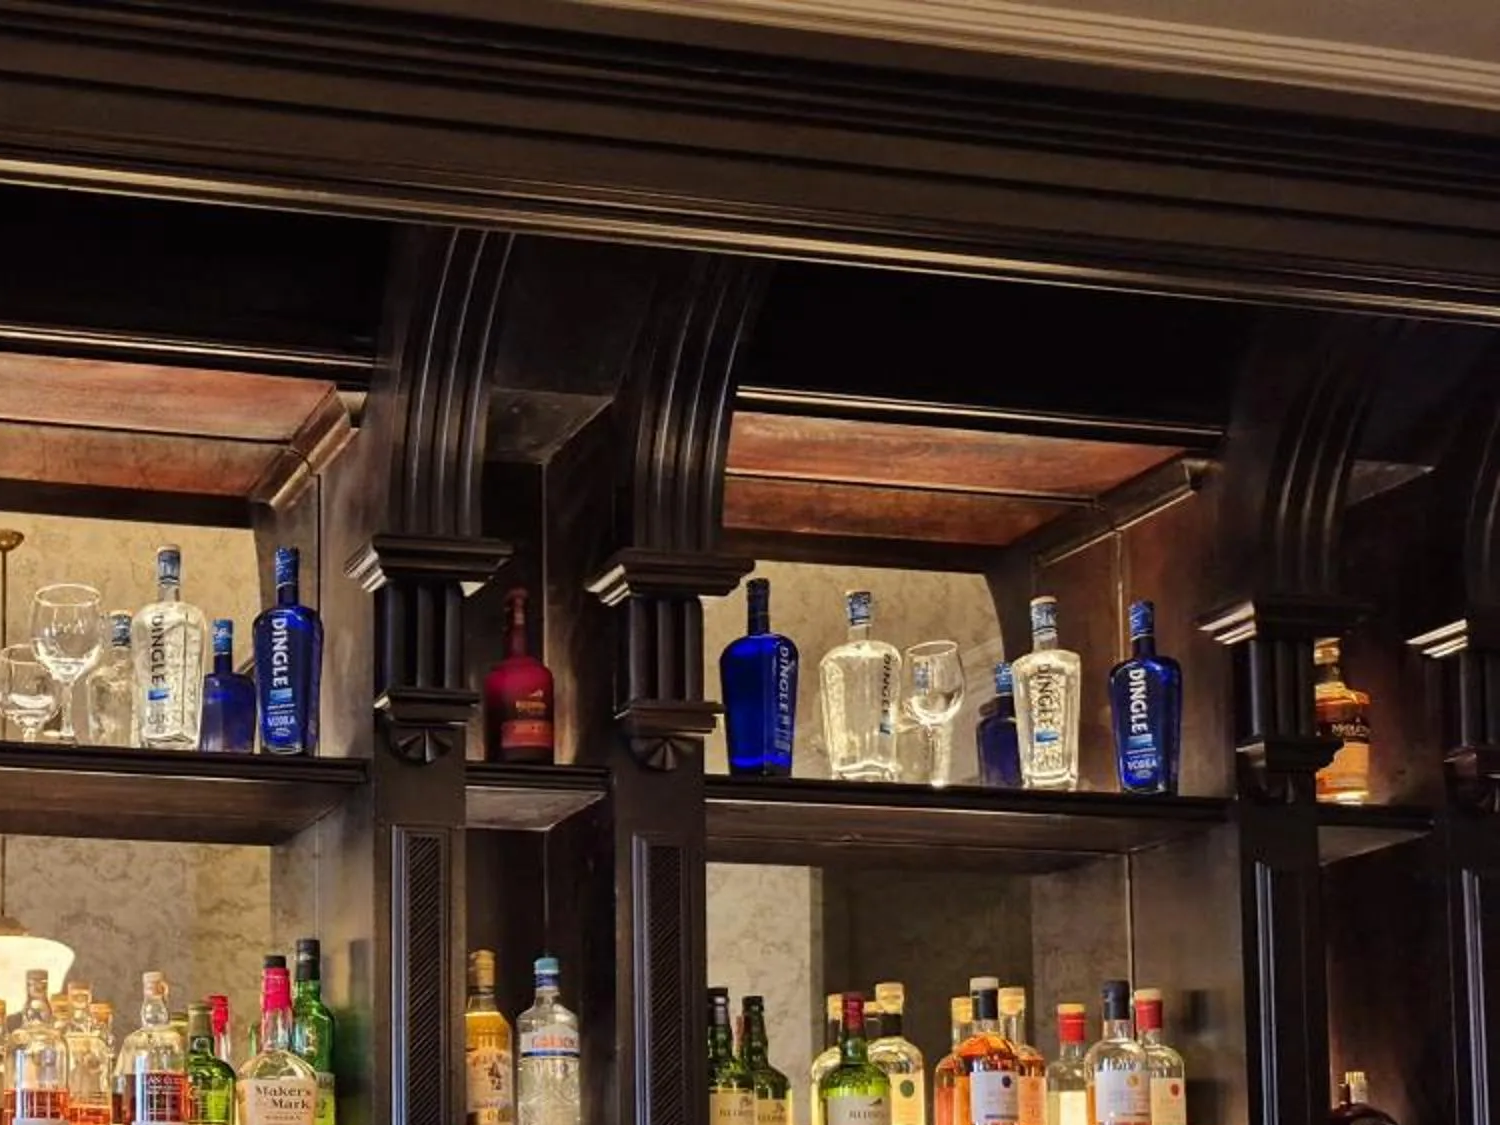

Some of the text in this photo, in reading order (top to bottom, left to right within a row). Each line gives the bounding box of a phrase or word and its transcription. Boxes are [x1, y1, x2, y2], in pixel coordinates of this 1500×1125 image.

[270, 618, 290, 687] DINGLE
[774, 645, 796, 714] DINGLE
[1130, 669, 1148, 735] DINGLE
[271, 1097, 311, 1110] Mark
